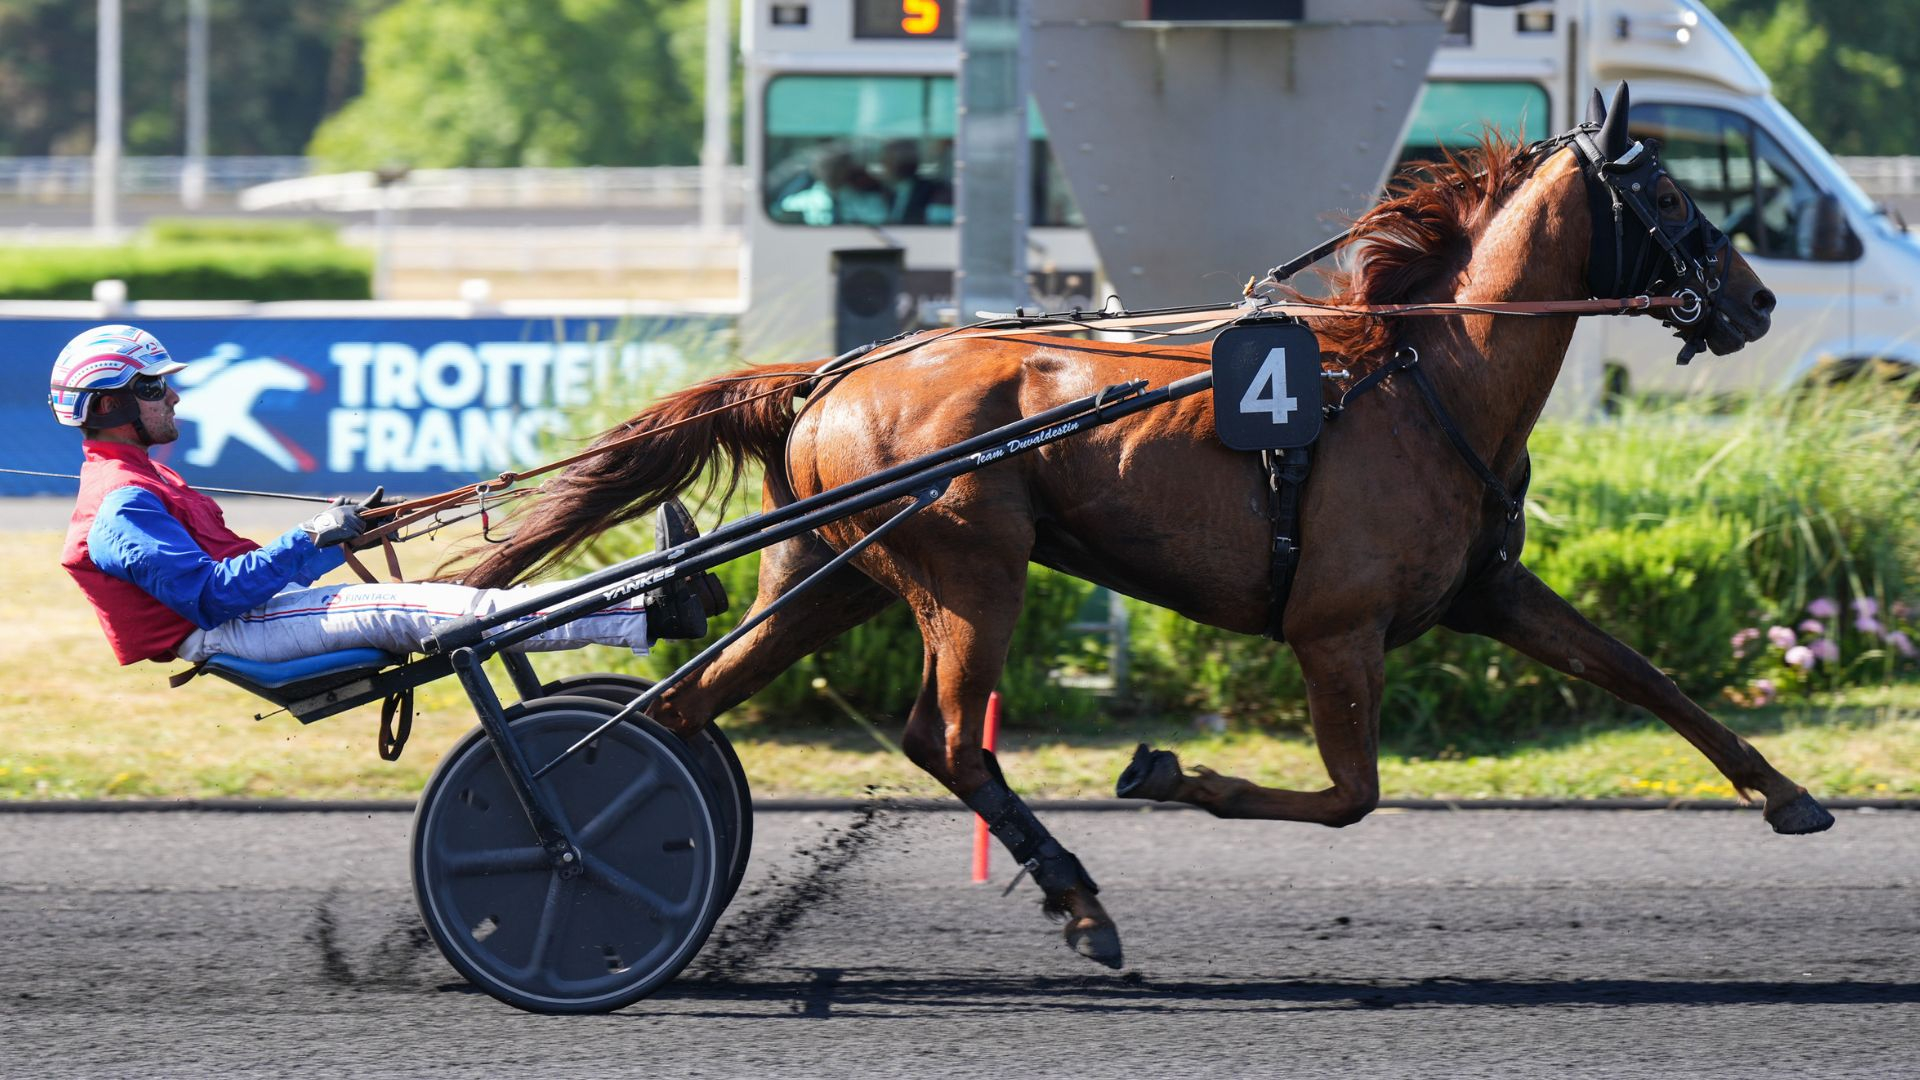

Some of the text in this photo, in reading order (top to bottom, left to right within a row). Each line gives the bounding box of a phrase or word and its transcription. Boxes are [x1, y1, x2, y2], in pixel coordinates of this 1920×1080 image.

[1240, 347, 1298, 424] 4
[327, 408, 571, 474] FRANC
[970, 421, 1080, 466] Team Duvaldestin
[344, 593, 398, 602] FINNTACK
[602, 566, 677, 601] YANKEE
